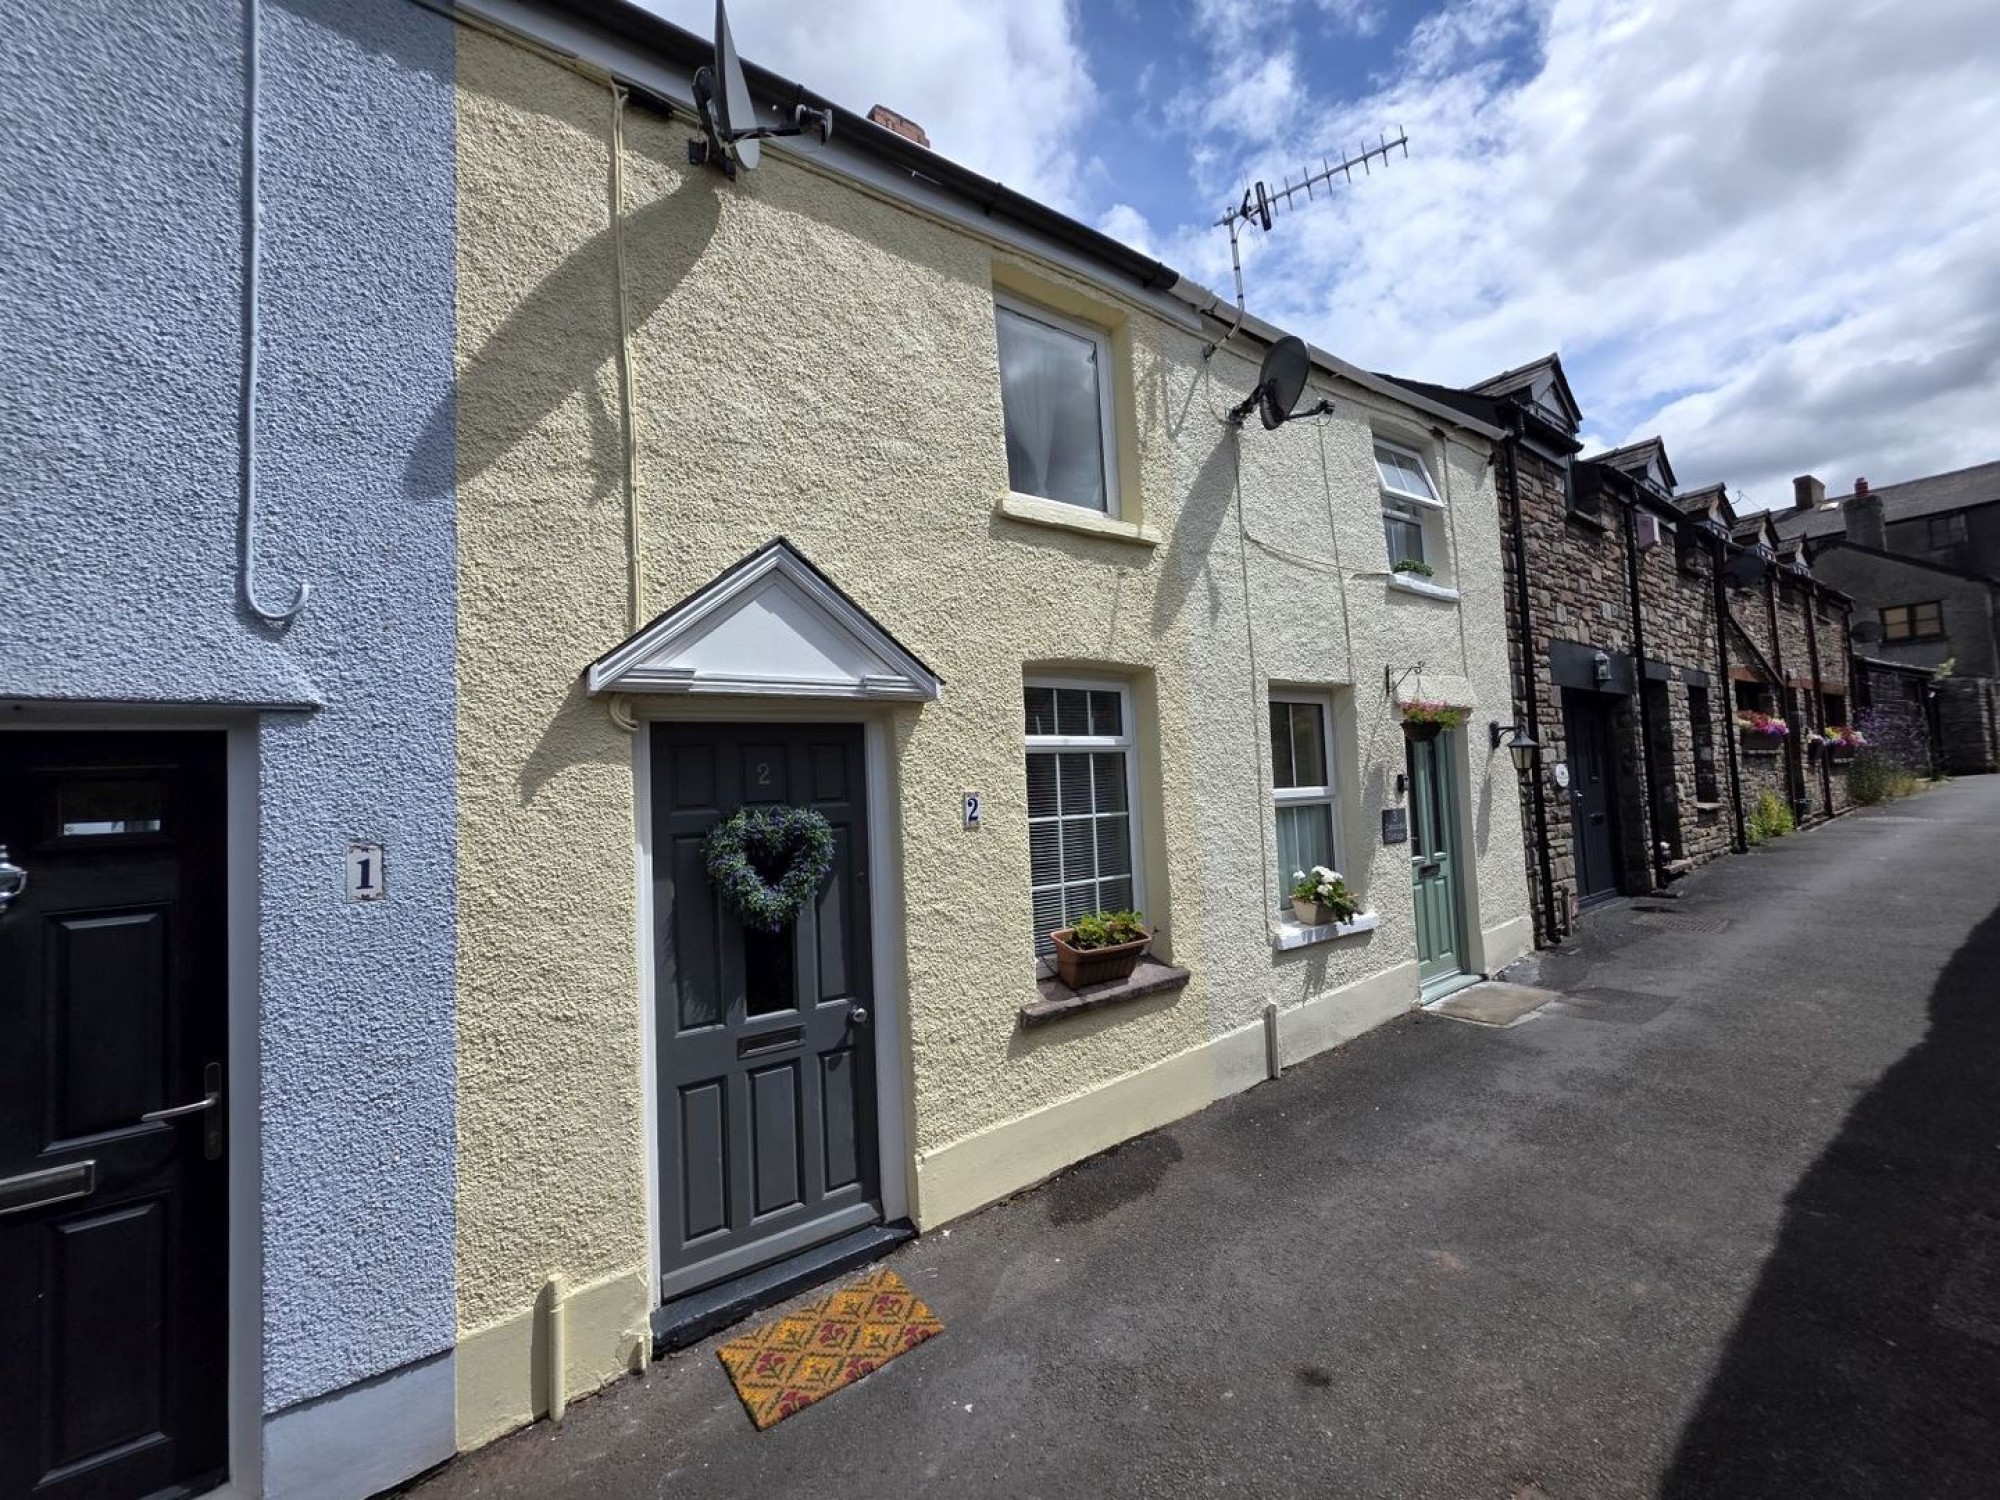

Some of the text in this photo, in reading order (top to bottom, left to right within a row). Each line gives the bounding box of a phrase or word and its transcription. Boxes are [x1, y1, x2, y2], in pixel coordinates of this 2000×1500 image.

[756, 763, 770, 785] 2
[967, 798, 979, 821] 2
[355, 858, 375, 890] 1
